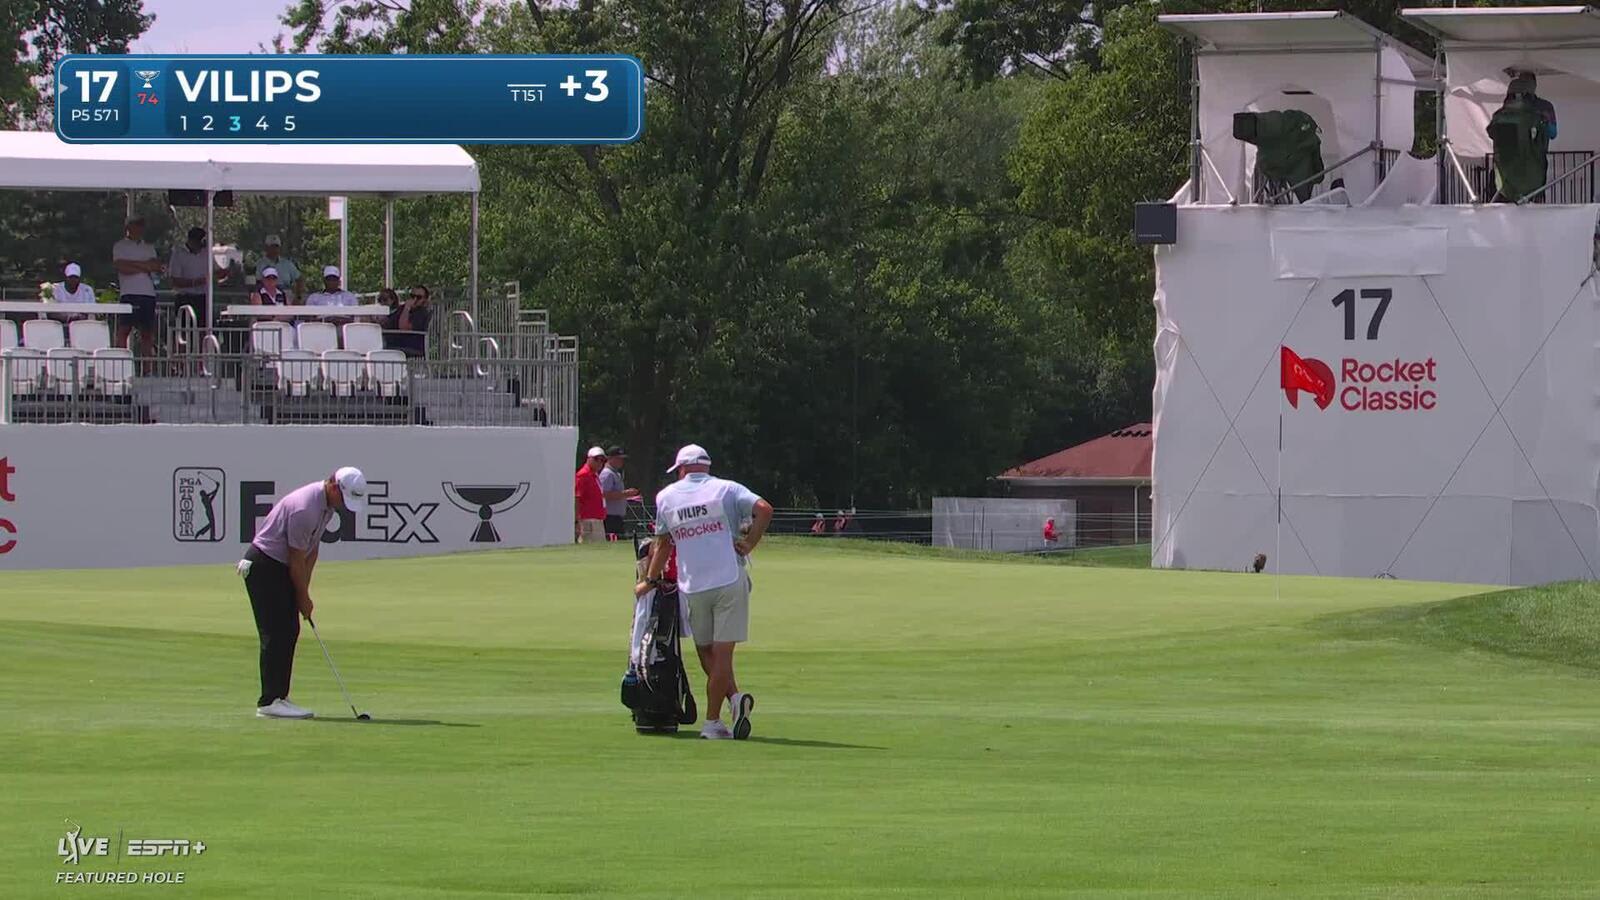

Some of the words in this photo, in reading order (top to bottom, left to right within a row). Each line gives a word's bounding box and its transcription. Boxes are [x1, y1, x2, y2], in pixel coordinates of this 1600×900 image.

[1331, 288, 1392, 340] 17
[1341, 357, 1437, 383] Rocket
[1340, 384, 1437, 411] Classic
[180, 486, 194, 536] TOUR
[240, 480, 439, 543] FdEx
[677, 504, 708, 520] VILIPS
[680, 521, 723, 539] Rocket
